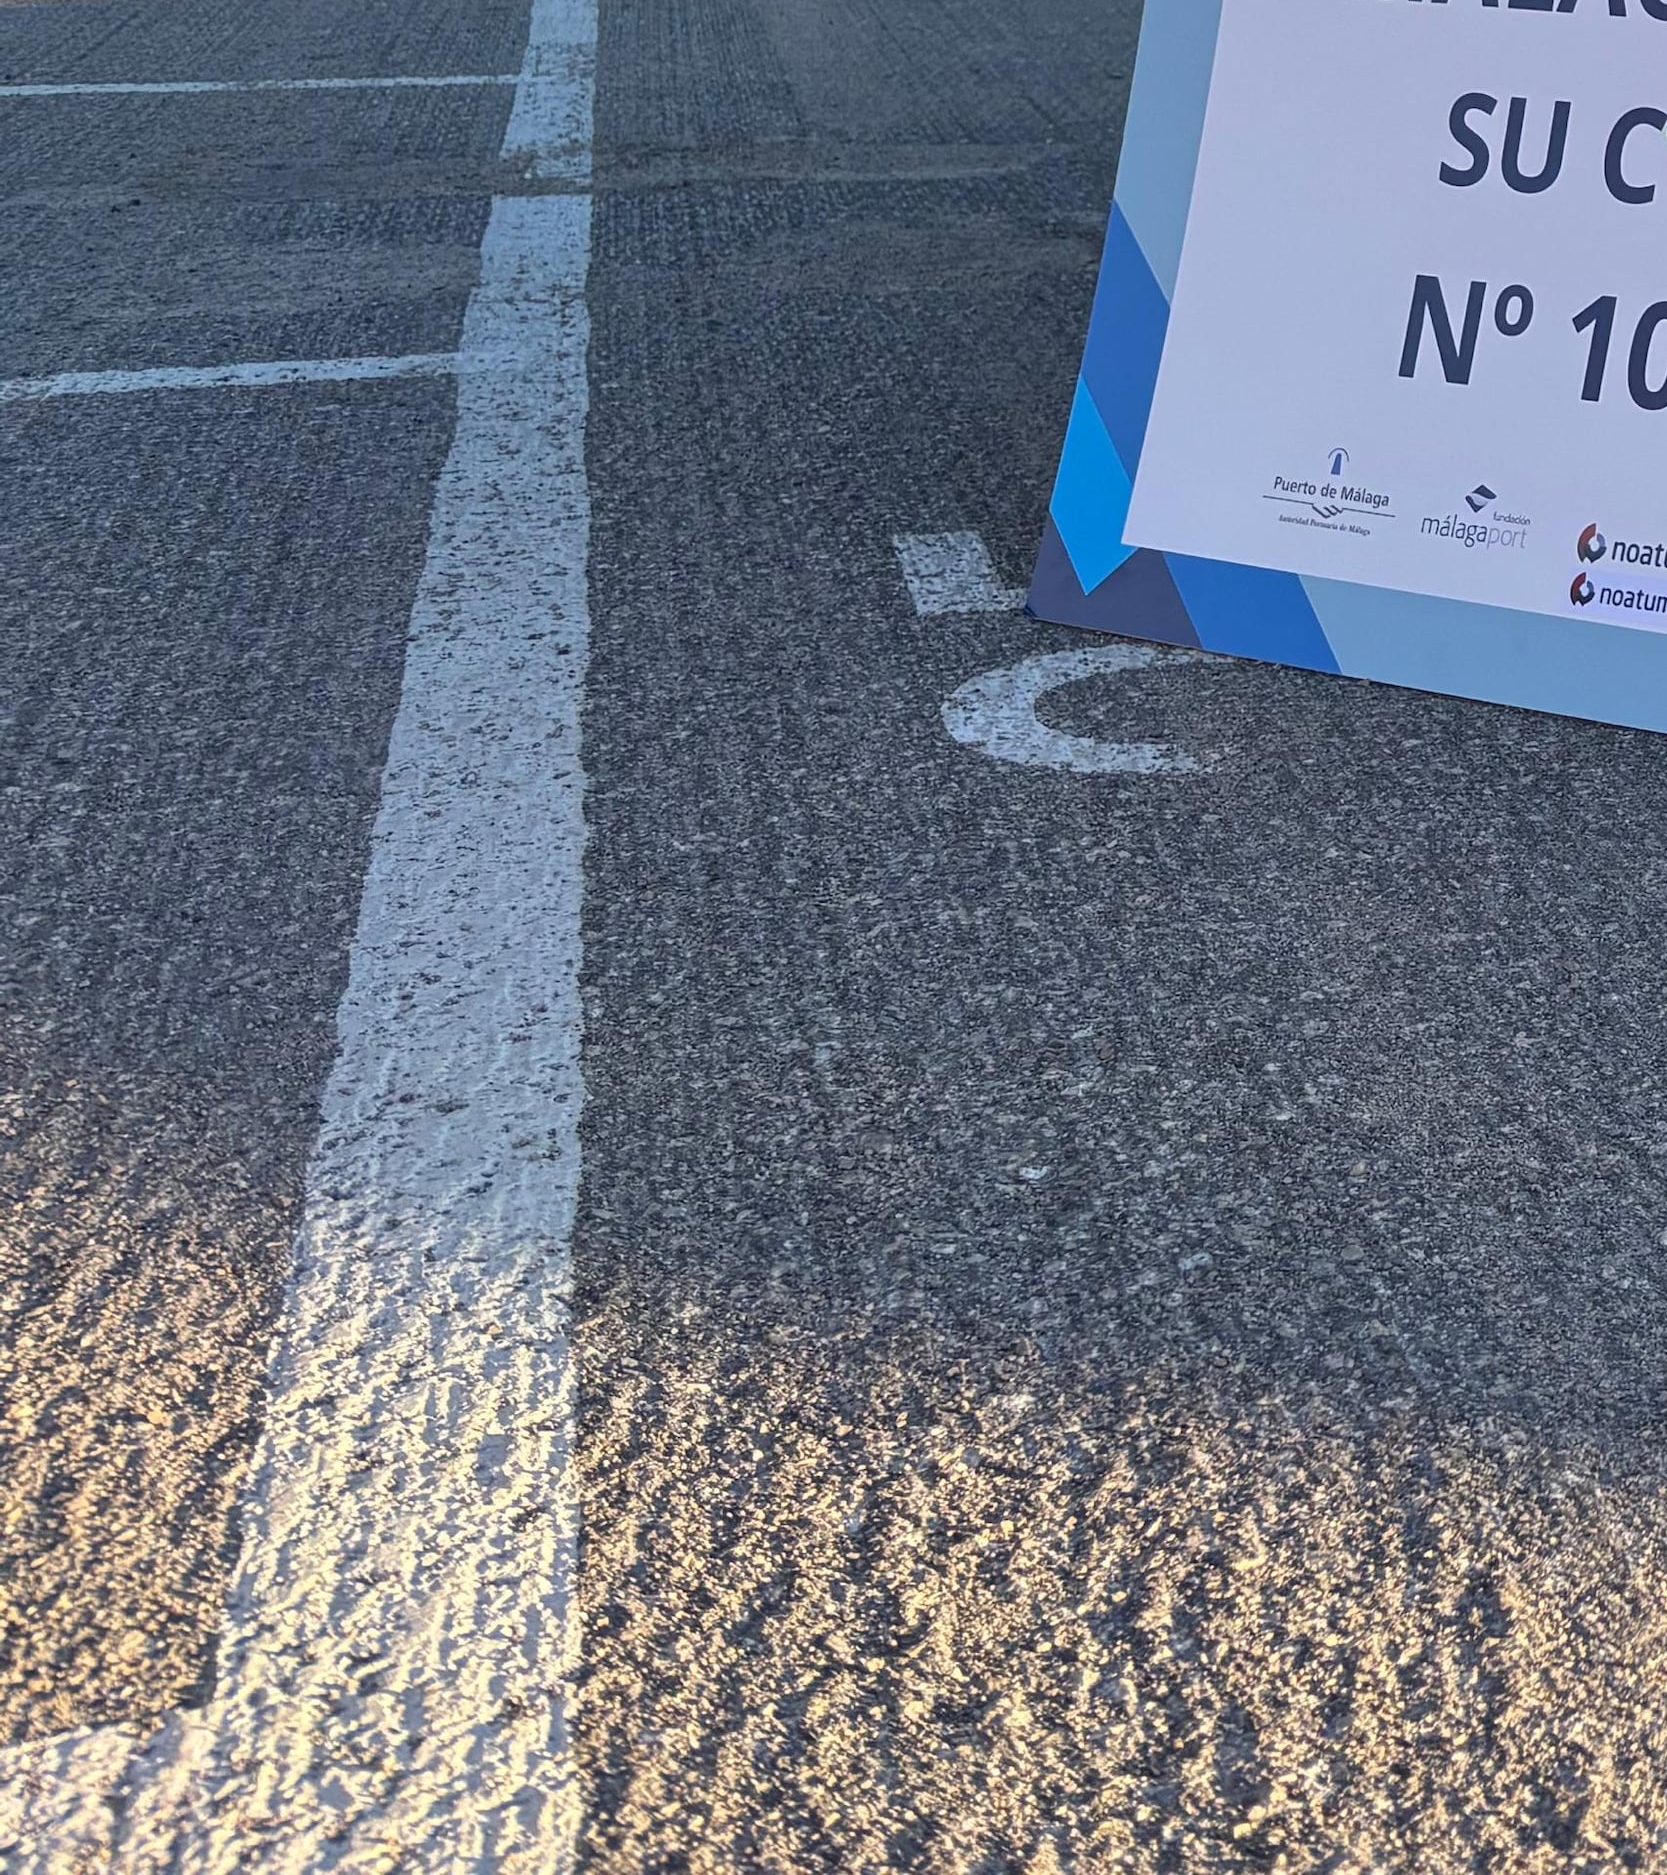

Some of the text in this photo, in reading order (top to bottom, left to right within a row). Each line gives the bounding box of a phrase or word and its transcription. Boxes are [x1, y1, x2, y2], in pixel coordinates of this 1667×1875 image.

[1439, 92, 1572, 194] SU
[1398, 274, 1534, 386] Nº
[1273, 476, 1390, 509] Puerto de Málaga
[1420, 514, 1528, 549] málagaport
[1493, 511, 1531, 525] fundación
